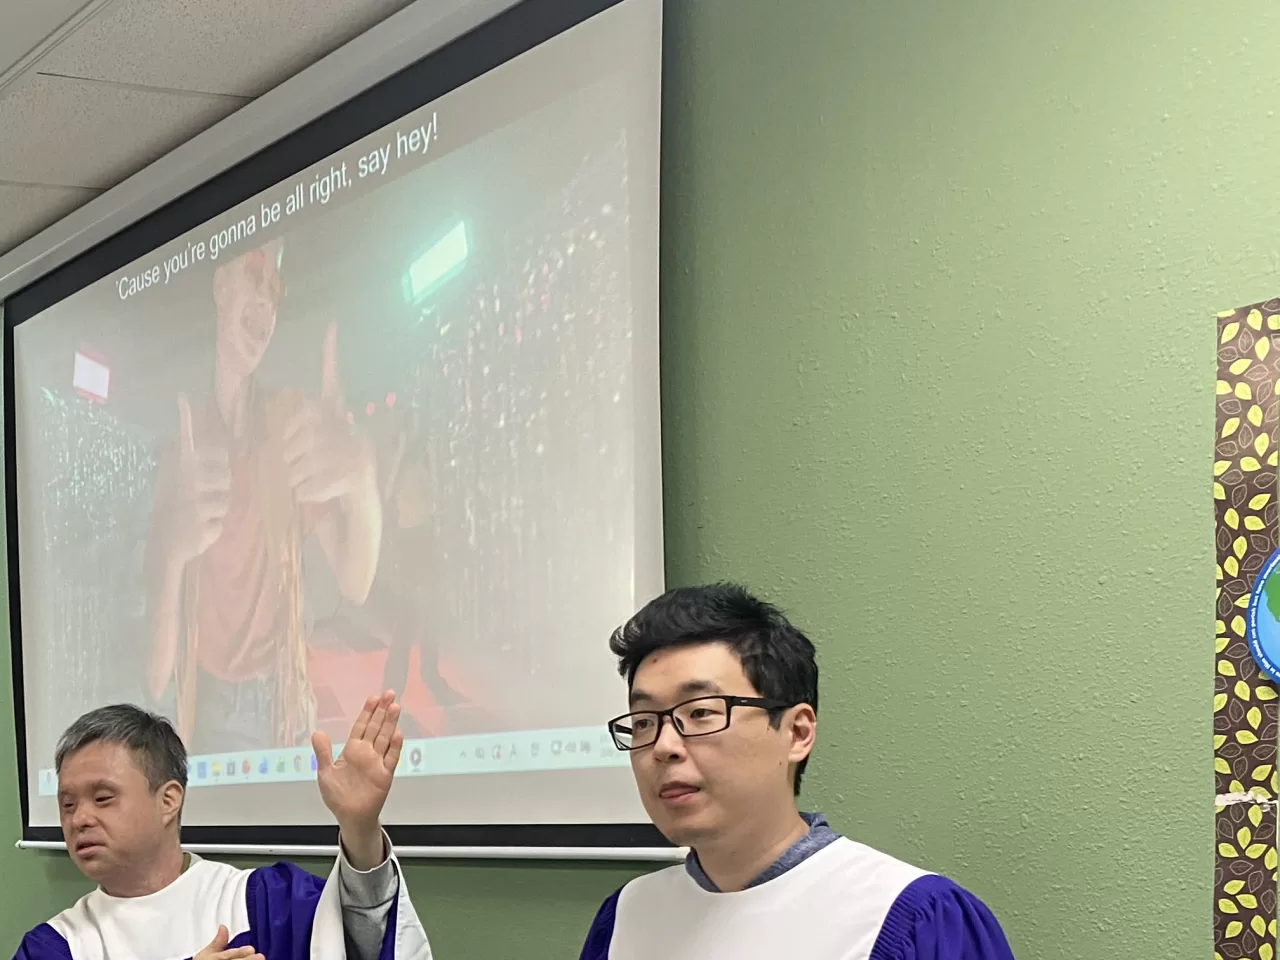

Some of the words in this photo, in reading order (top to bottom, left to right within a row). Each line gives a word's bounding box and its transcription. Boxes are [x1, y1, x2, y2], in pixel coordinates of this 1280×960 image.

[163, 241, 206, 284] you're
[209, 214, 257, 260] gonna
[261, 202, 281, 228] be
[285, 183, 304, 215] all
[309, 161, 352, 204] right,
[357, 143, 391, 178] say
[396, 112, 438, 158] hey!
